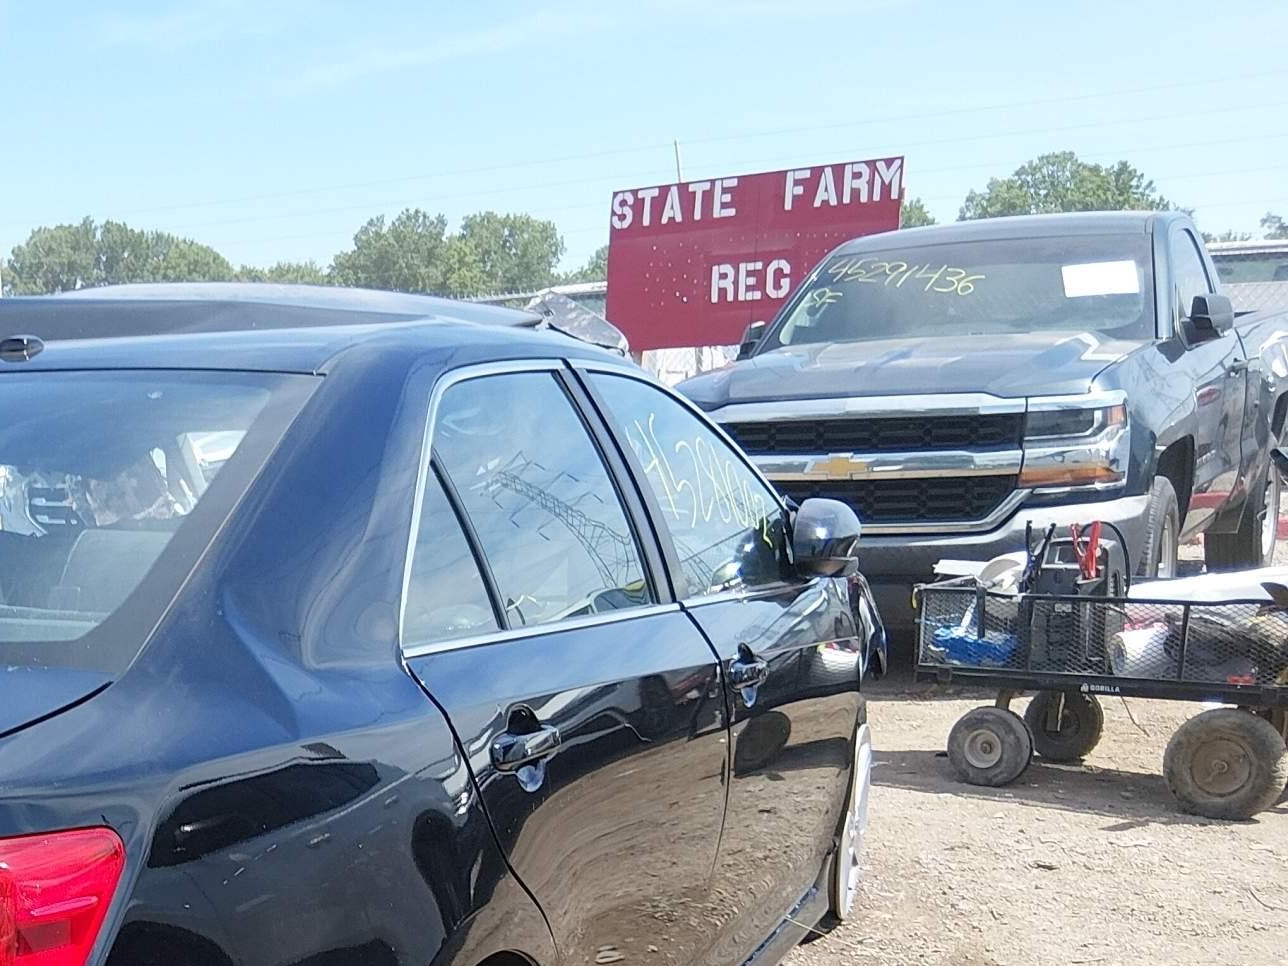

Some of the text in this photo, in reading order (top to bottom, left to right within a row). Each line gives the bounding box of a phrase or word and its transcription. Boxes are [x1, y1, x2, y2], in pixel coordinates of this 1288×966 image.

[611, 158, 903, 230] STATE FARM
[710, 258, 792, 304] REG
[828, 257, 986, 296] 45291436
[1089, 684, 1121, 693] GORILLA
